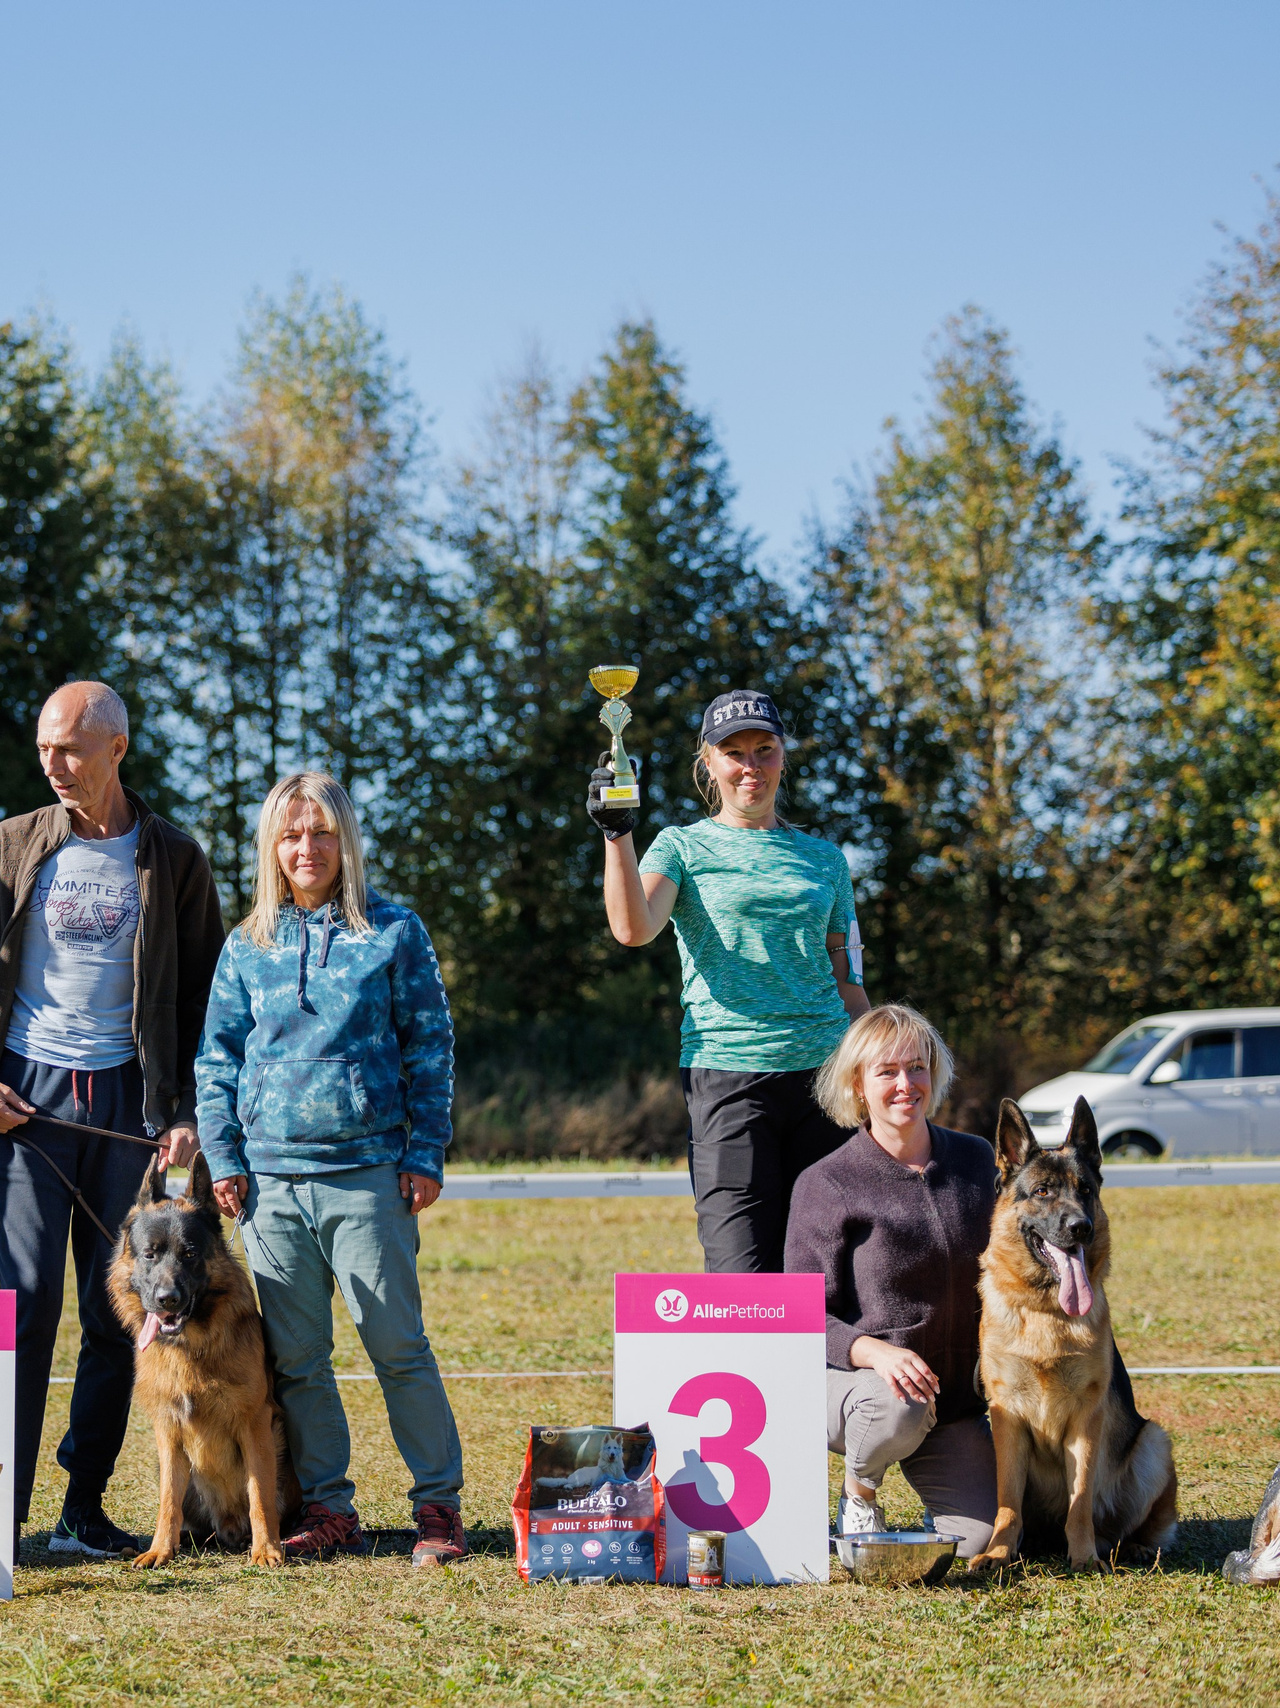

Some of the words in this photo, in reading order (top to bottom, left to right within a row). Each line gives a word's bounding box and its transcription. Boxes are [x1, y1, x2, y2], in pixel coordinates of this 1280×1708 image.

[713, 700, 770, 726] STYLE
[692, 1303, 785, 1318] AllerPetfood
[664, 1372, 771, 1532] 3
[557, 1494, 627, 1511] BUFFALO
[551, 1521, 581, 1531] ADULT
[588, 1519, 633, 1530] SENSITIVE
